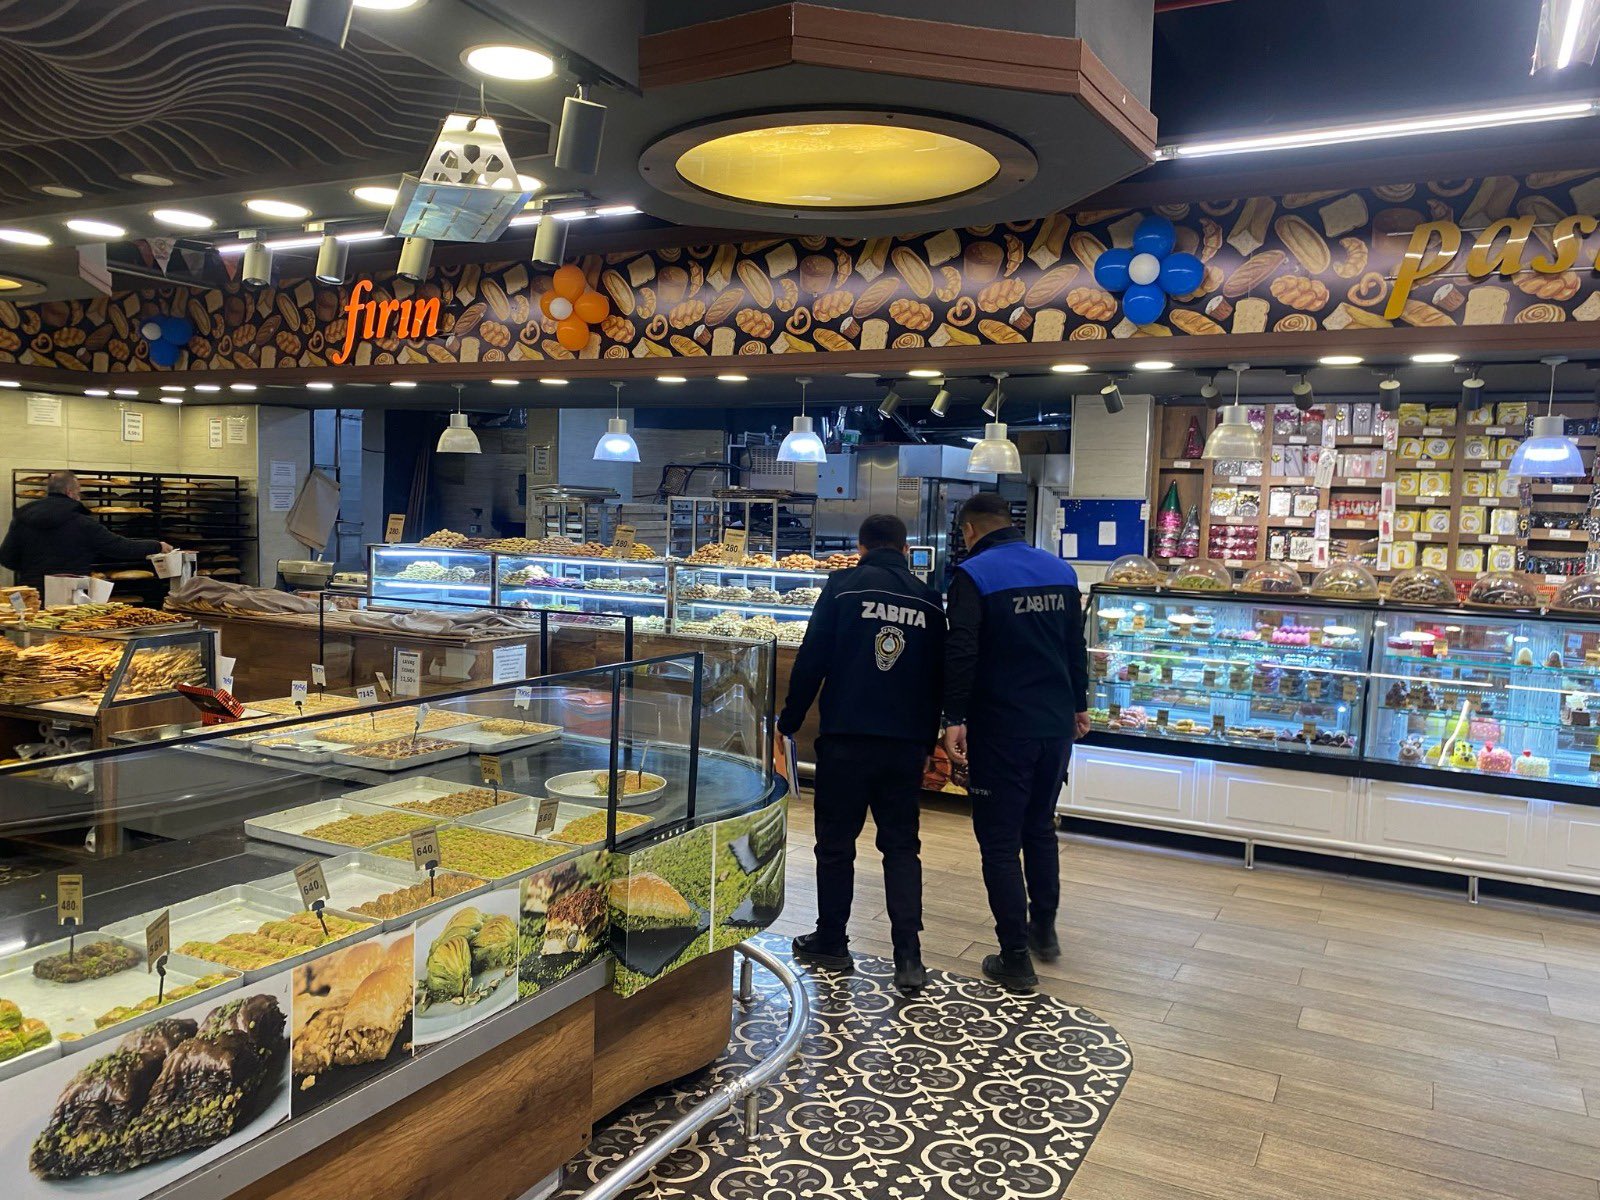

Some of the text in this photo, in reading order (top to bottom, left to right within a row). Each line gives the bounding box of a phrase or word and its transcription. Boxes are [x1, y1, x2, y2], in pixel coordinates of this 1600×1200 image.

[1384, 214, 1600, 320] pas
[332, 279, 440, 365] fırın
[1520, 519, 1528, 531] 6
[615, 539, 628, 549] 280
[725, 543, 739, 554] 280
[1012, 594, 1066, 614] ZABITA
[861, 601, 927, 629] ZABITA
